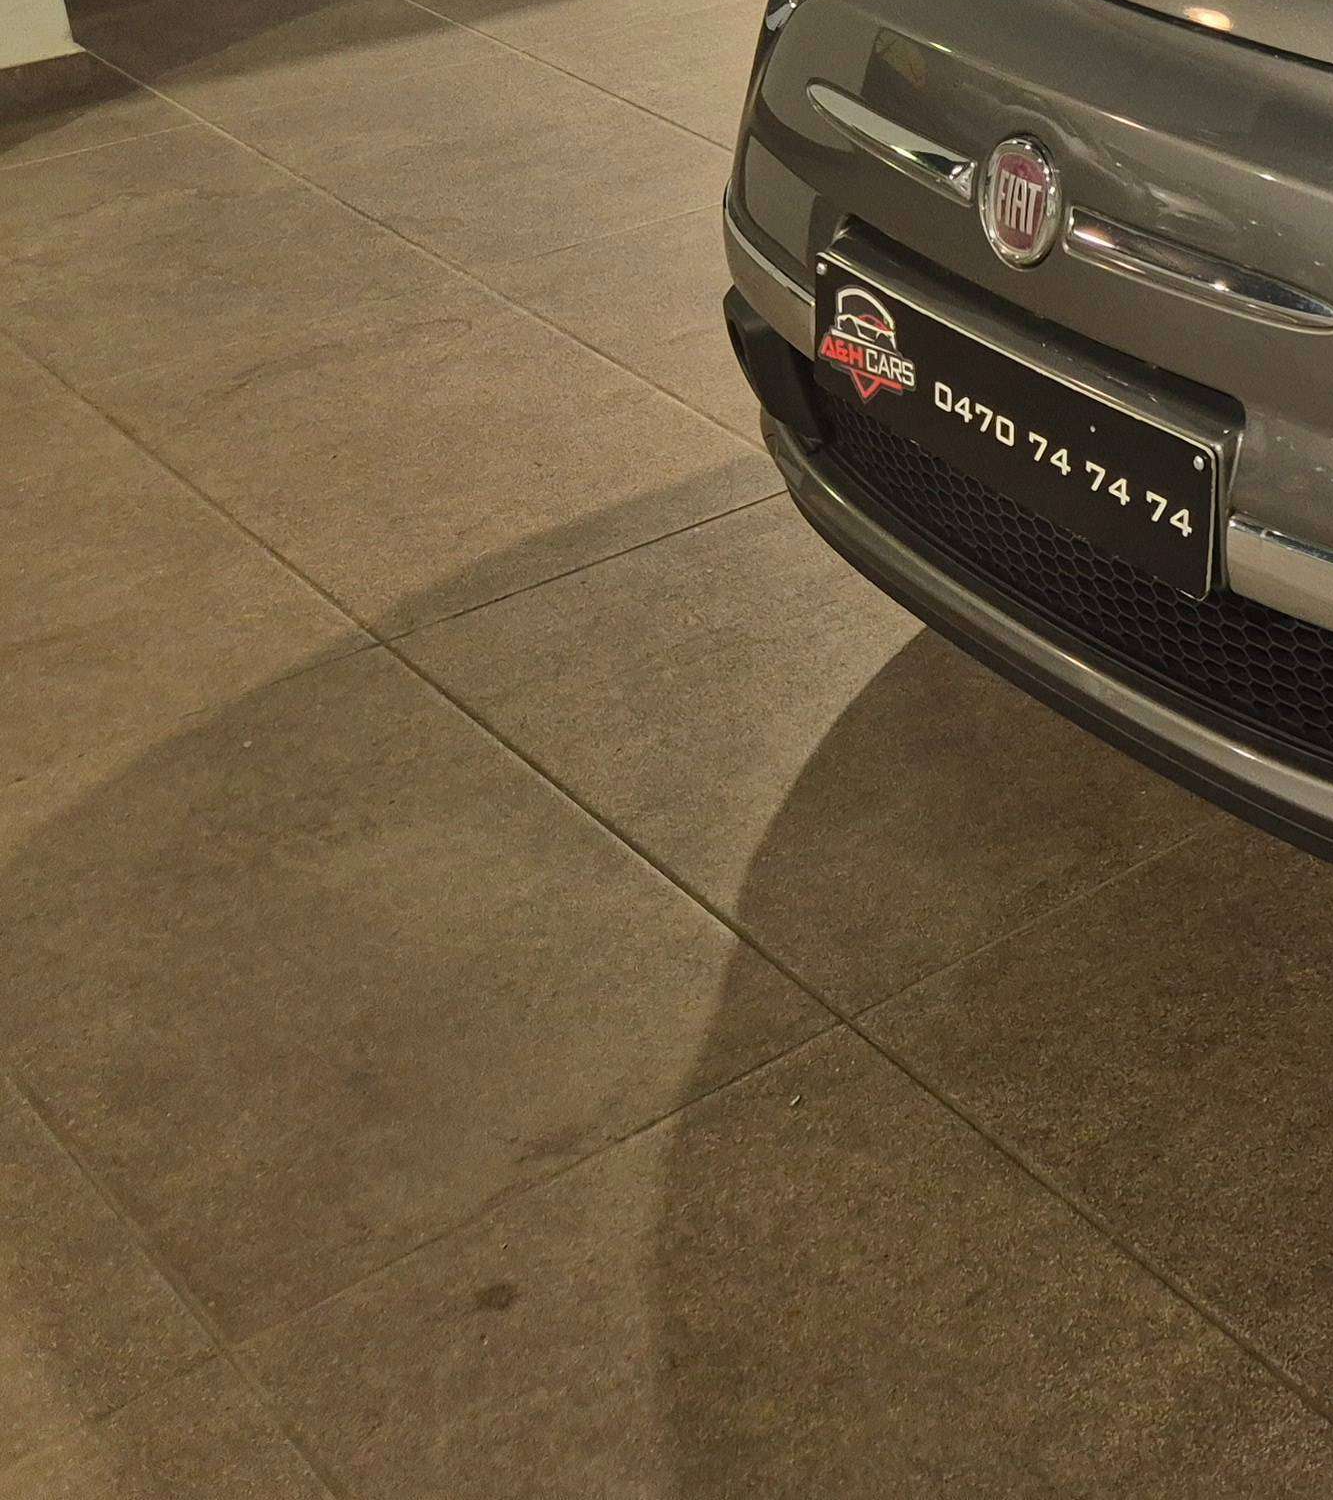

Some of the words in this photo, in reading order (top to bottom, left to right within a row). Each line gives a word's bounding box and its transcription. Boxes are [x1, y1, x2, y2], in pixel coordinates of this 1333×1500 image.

[997, 168, 1042, 235] FIAT
[821, 335, 865, 369] A&H
[865, 348, 915, 387] CARS
[934, 381, 1015, 447] 0470
[1028, 431, 1071, 476] 74
[1085, 460, 1130, 506] 74
[1146, 490, 1193, 537] 74
